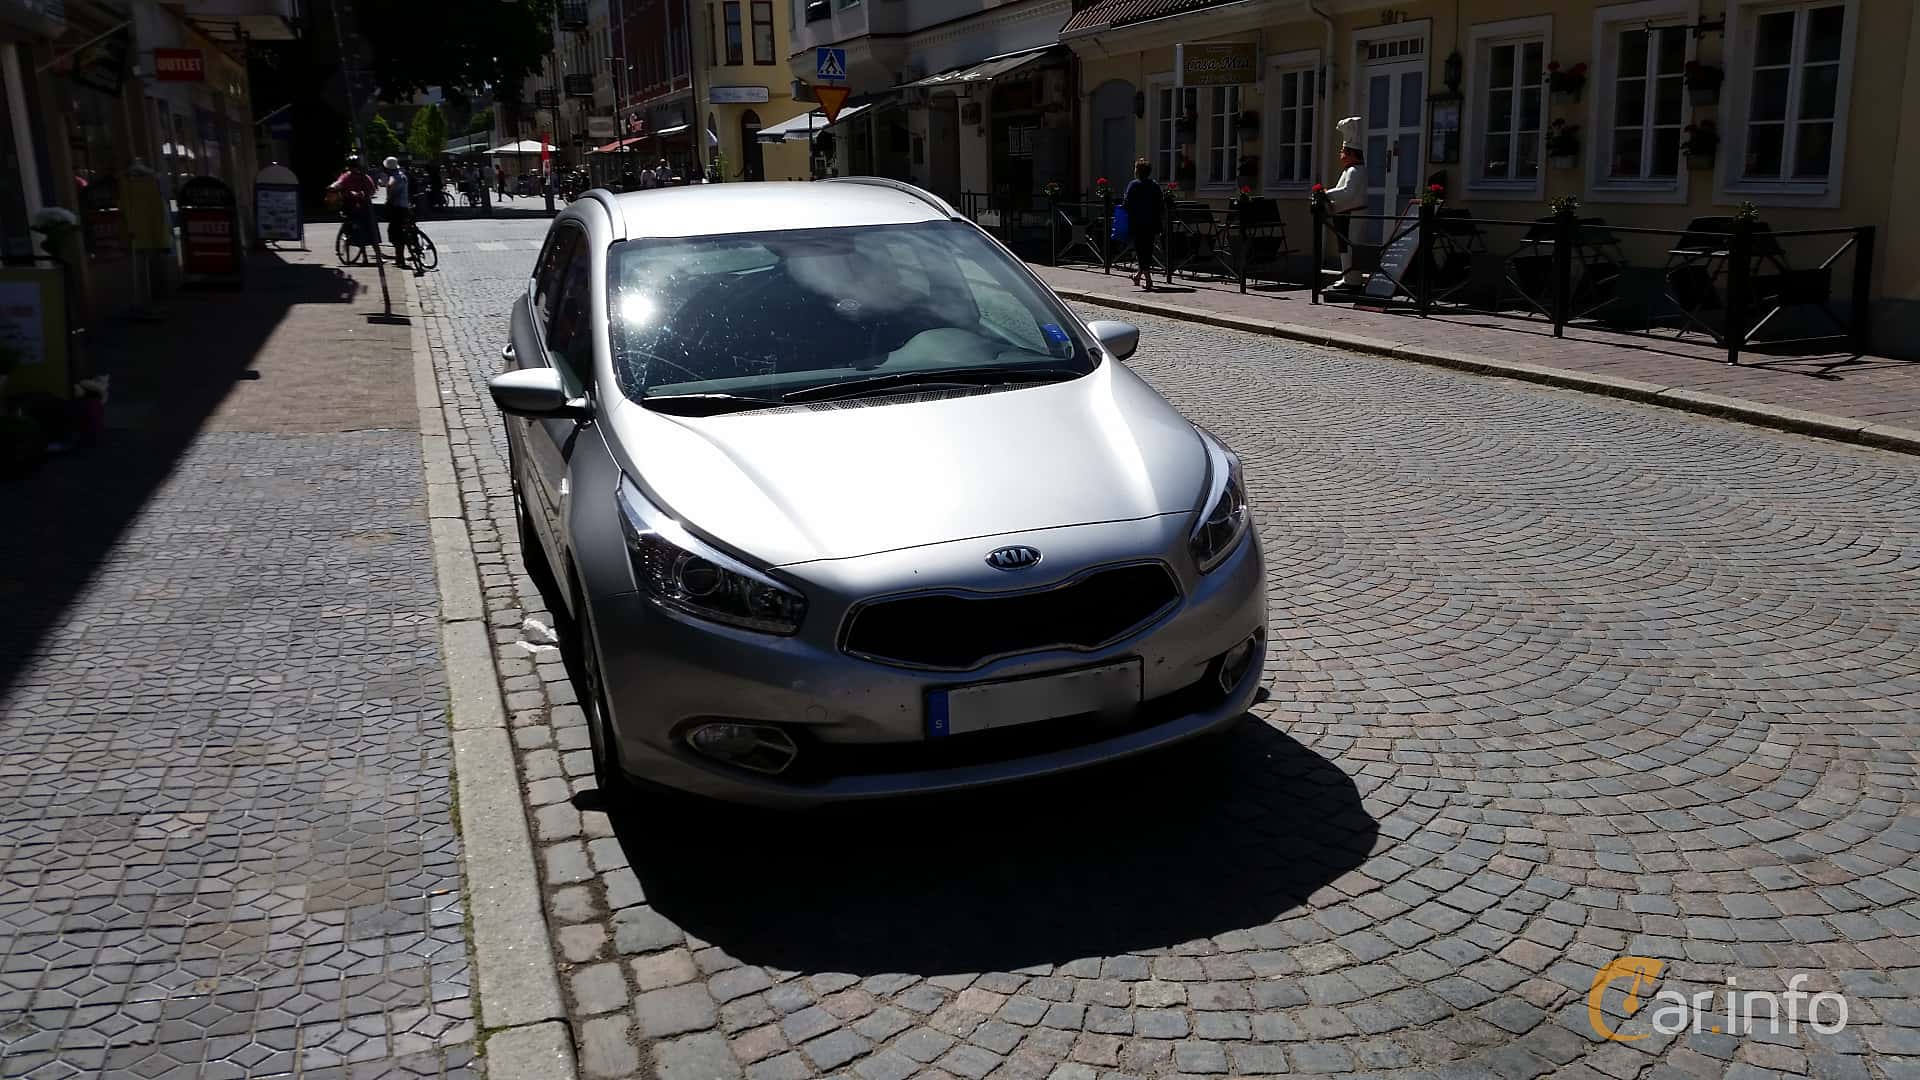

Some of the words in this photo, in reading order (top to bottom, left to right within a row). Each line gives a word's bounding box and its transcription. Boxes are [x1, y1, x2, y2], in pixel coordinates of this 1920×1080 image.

[158, 57, 201, 71] OUTLET
[995, 549, 1035, 565] KIA
[935, 719, 943, 729] S
